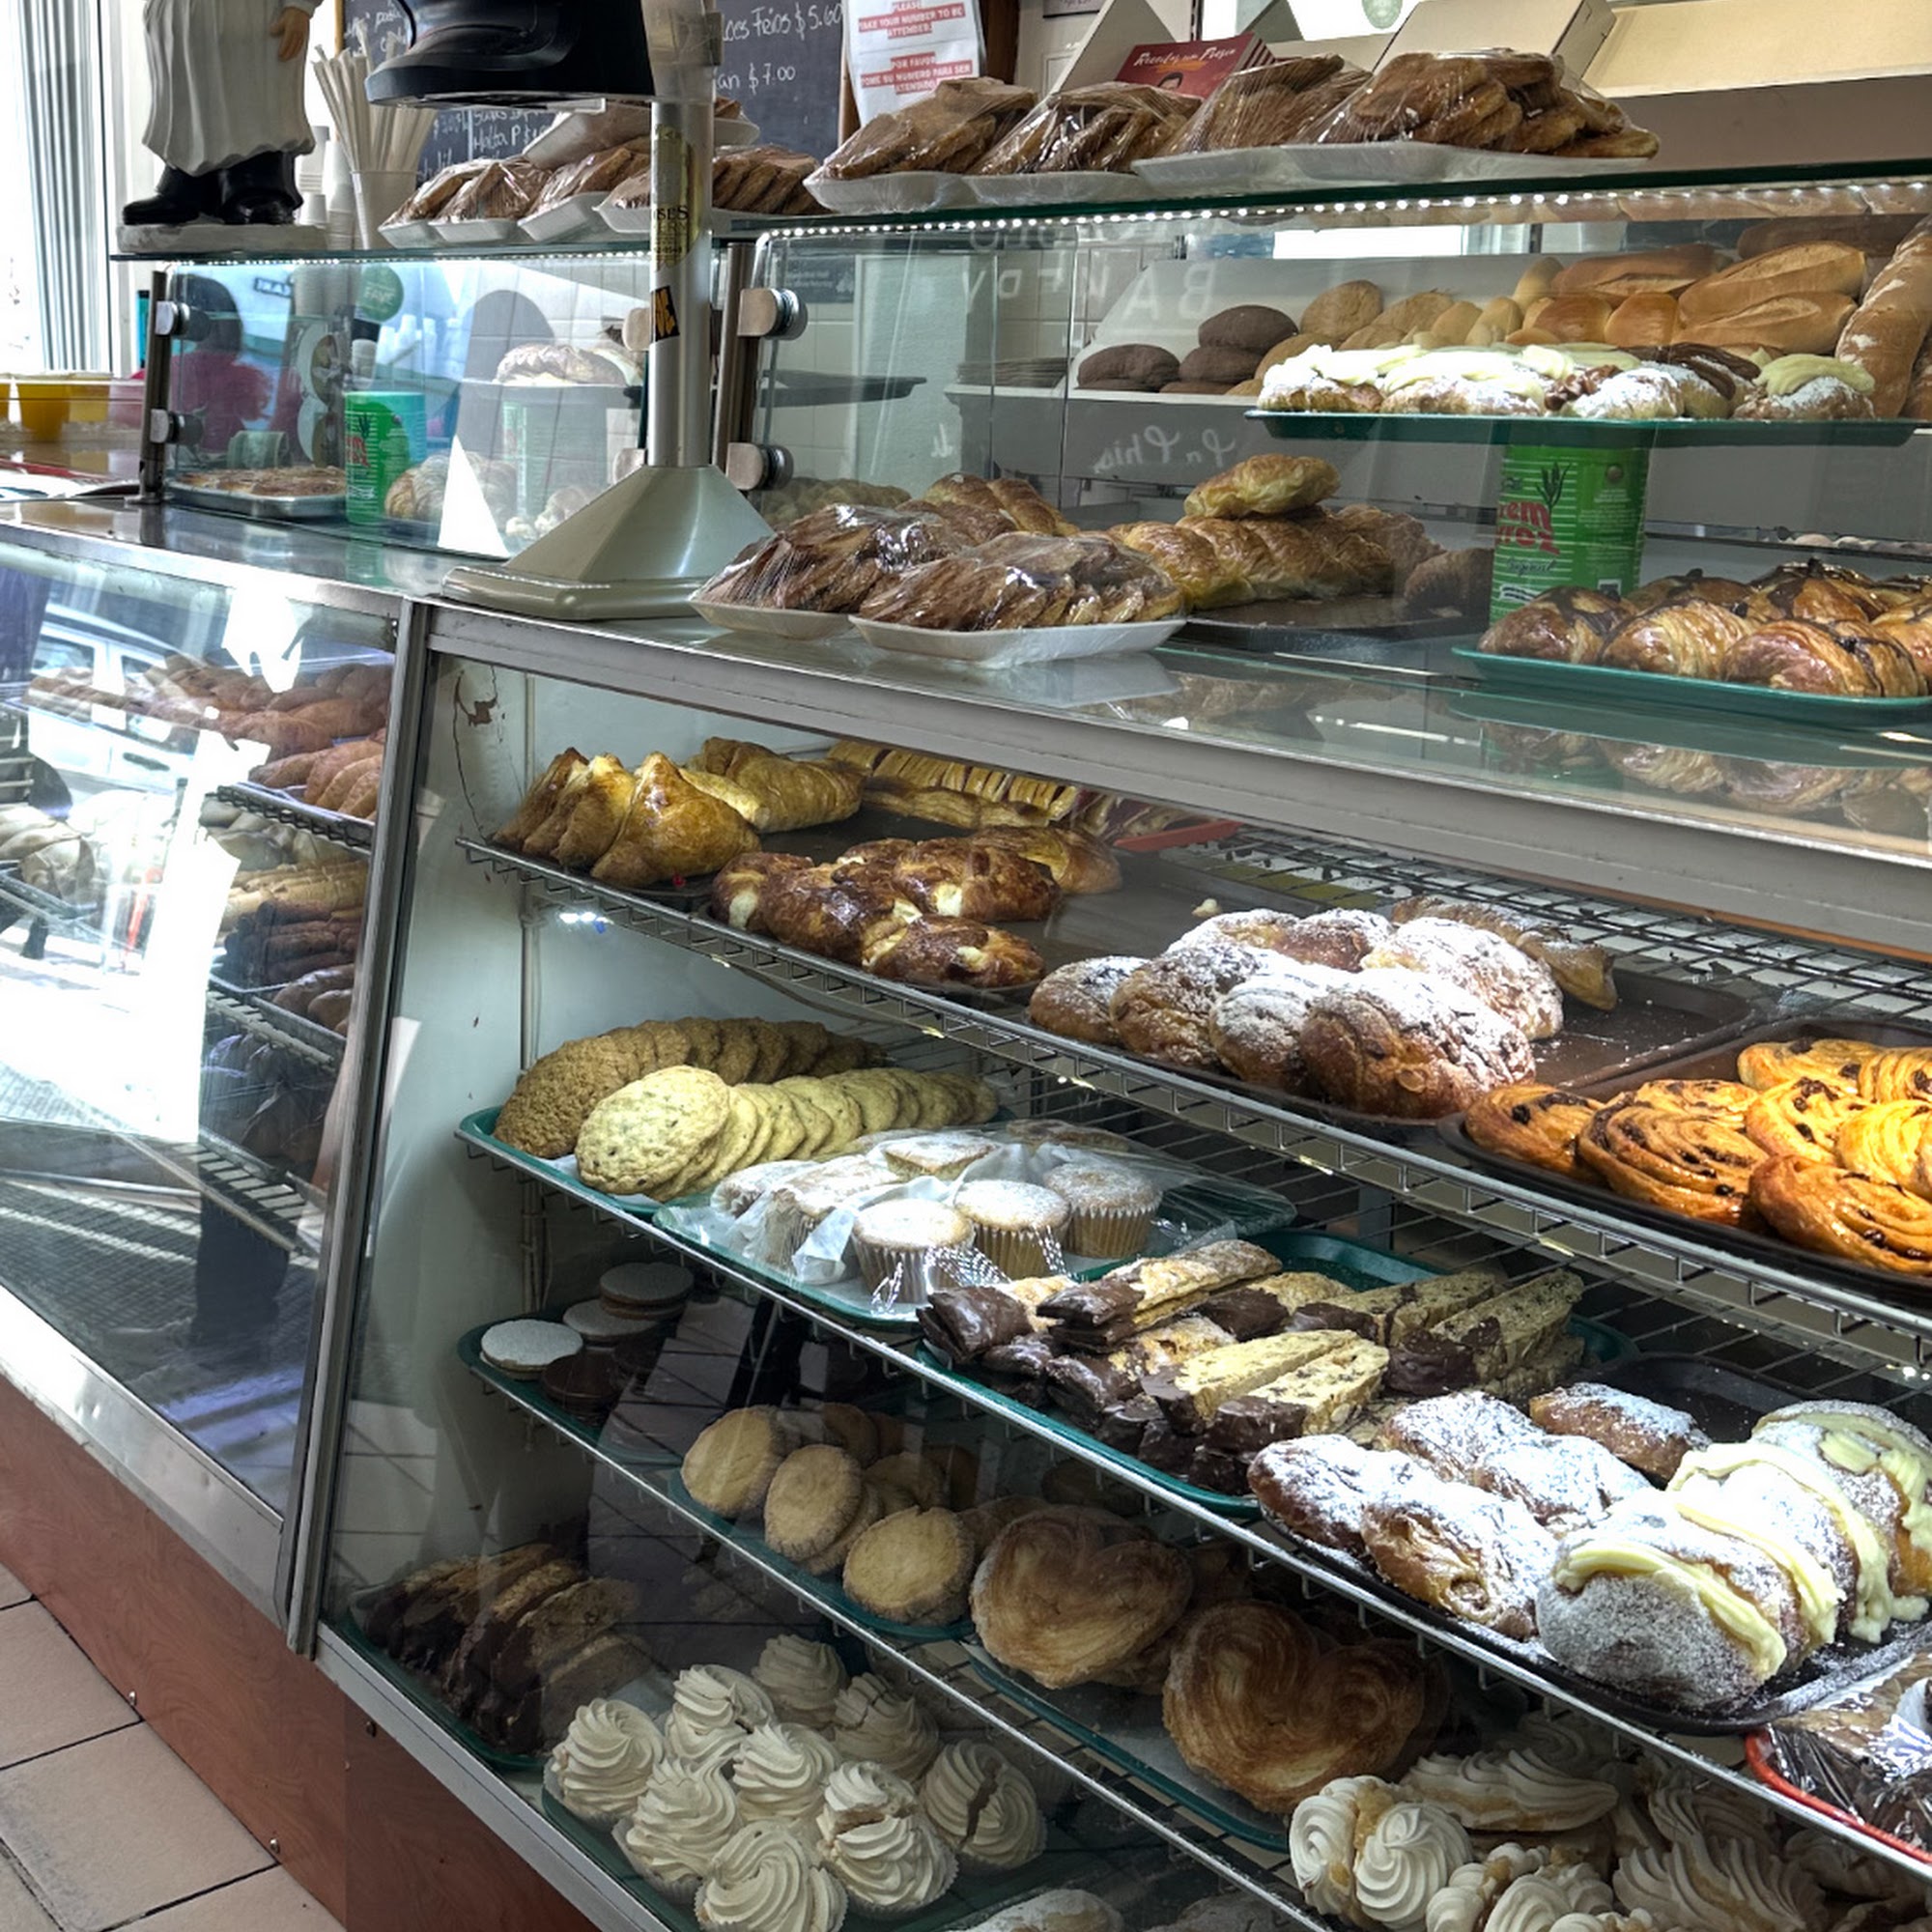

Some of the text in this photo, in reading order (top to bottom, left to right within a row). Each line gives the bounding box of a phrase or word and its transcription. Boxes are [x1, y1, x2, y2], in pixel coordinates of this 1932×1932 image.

[901, 12, 936, 23] NUMBER
[938, 8, 950, 17] TO
[952, 7, 963, 16] BE
[714, 67, 740, 90] an
[953, 65, 971, 74] SER
[1498, 501, 1552, 532] rem
[1497, 526, 1560, 556] rroz
